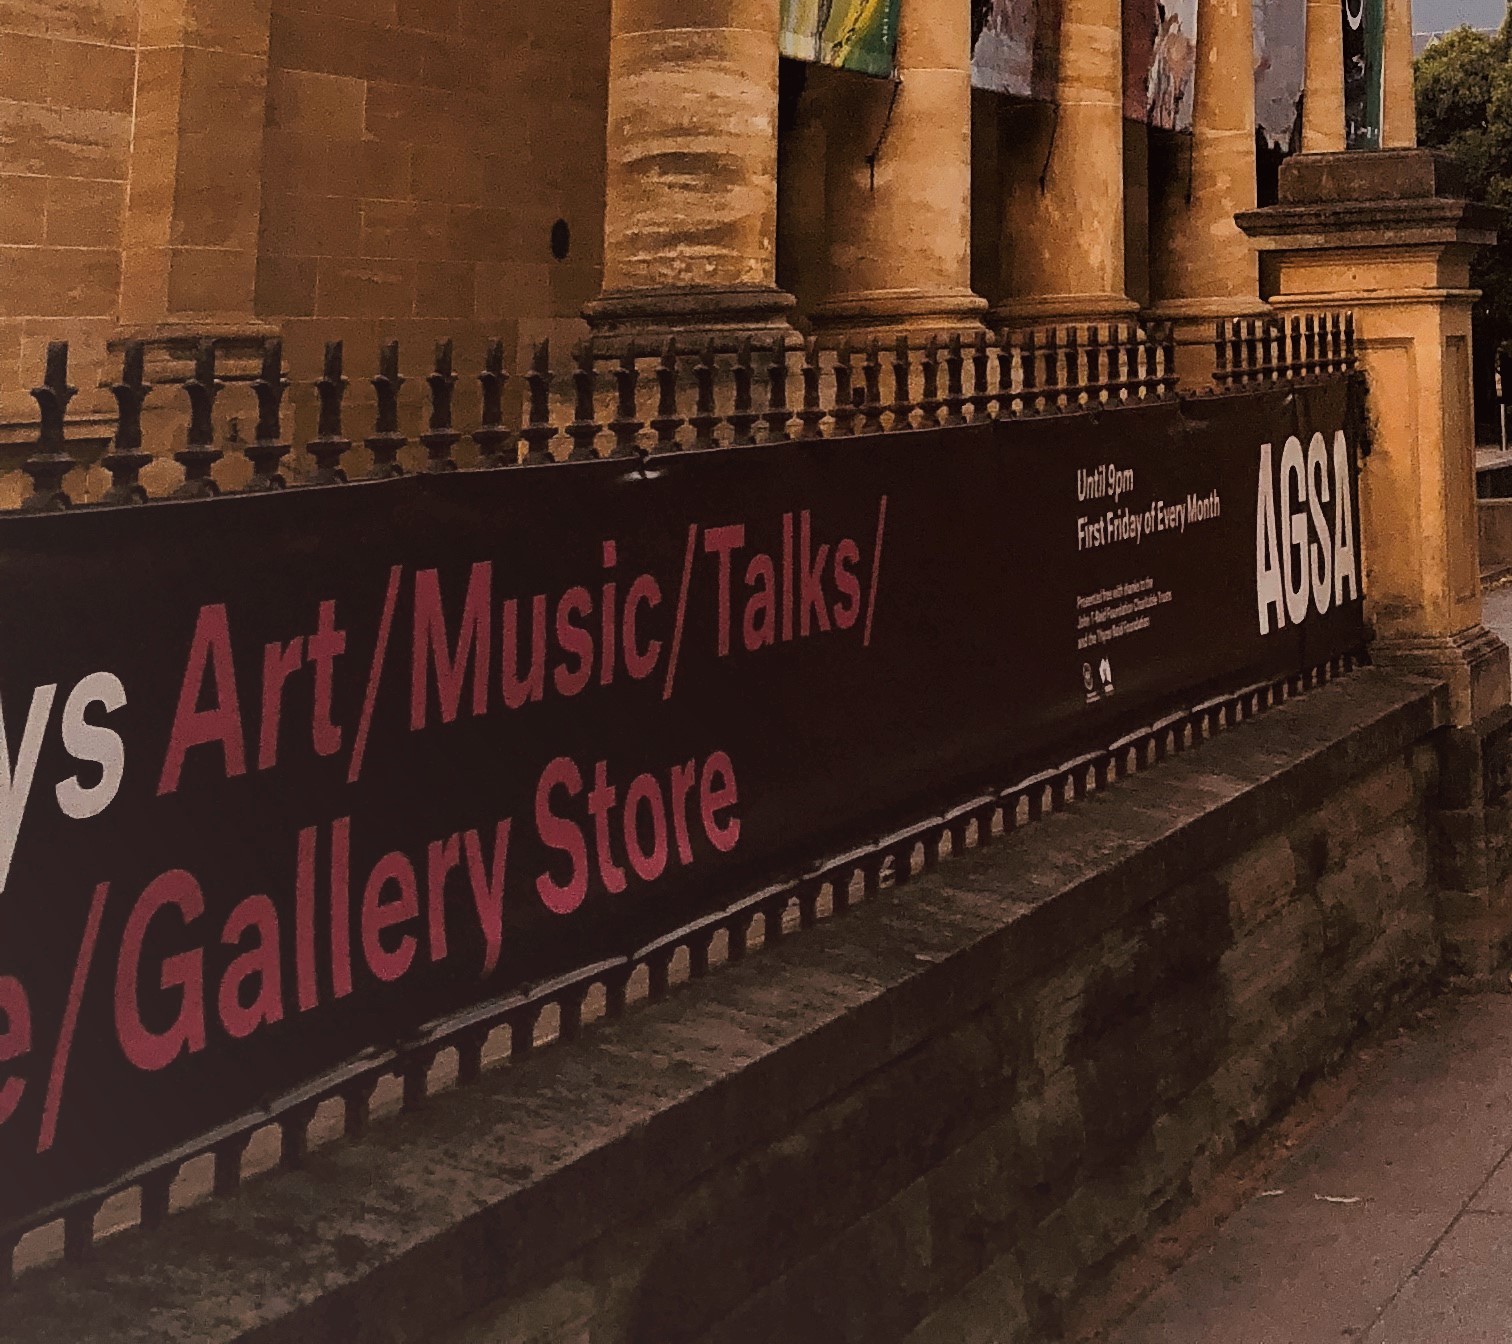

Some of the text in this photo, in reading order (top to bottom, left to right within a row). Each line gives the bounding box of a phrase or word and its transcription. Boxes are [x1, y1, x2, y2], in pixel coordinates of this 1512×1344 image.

[1077, 463, 1133, 503] Until 9pm
[1077, 488, 1220, 551] First Friday of Every Month
[1256, 430, 1357, 636] AGSA
[534, 750, 741, 915] Store
